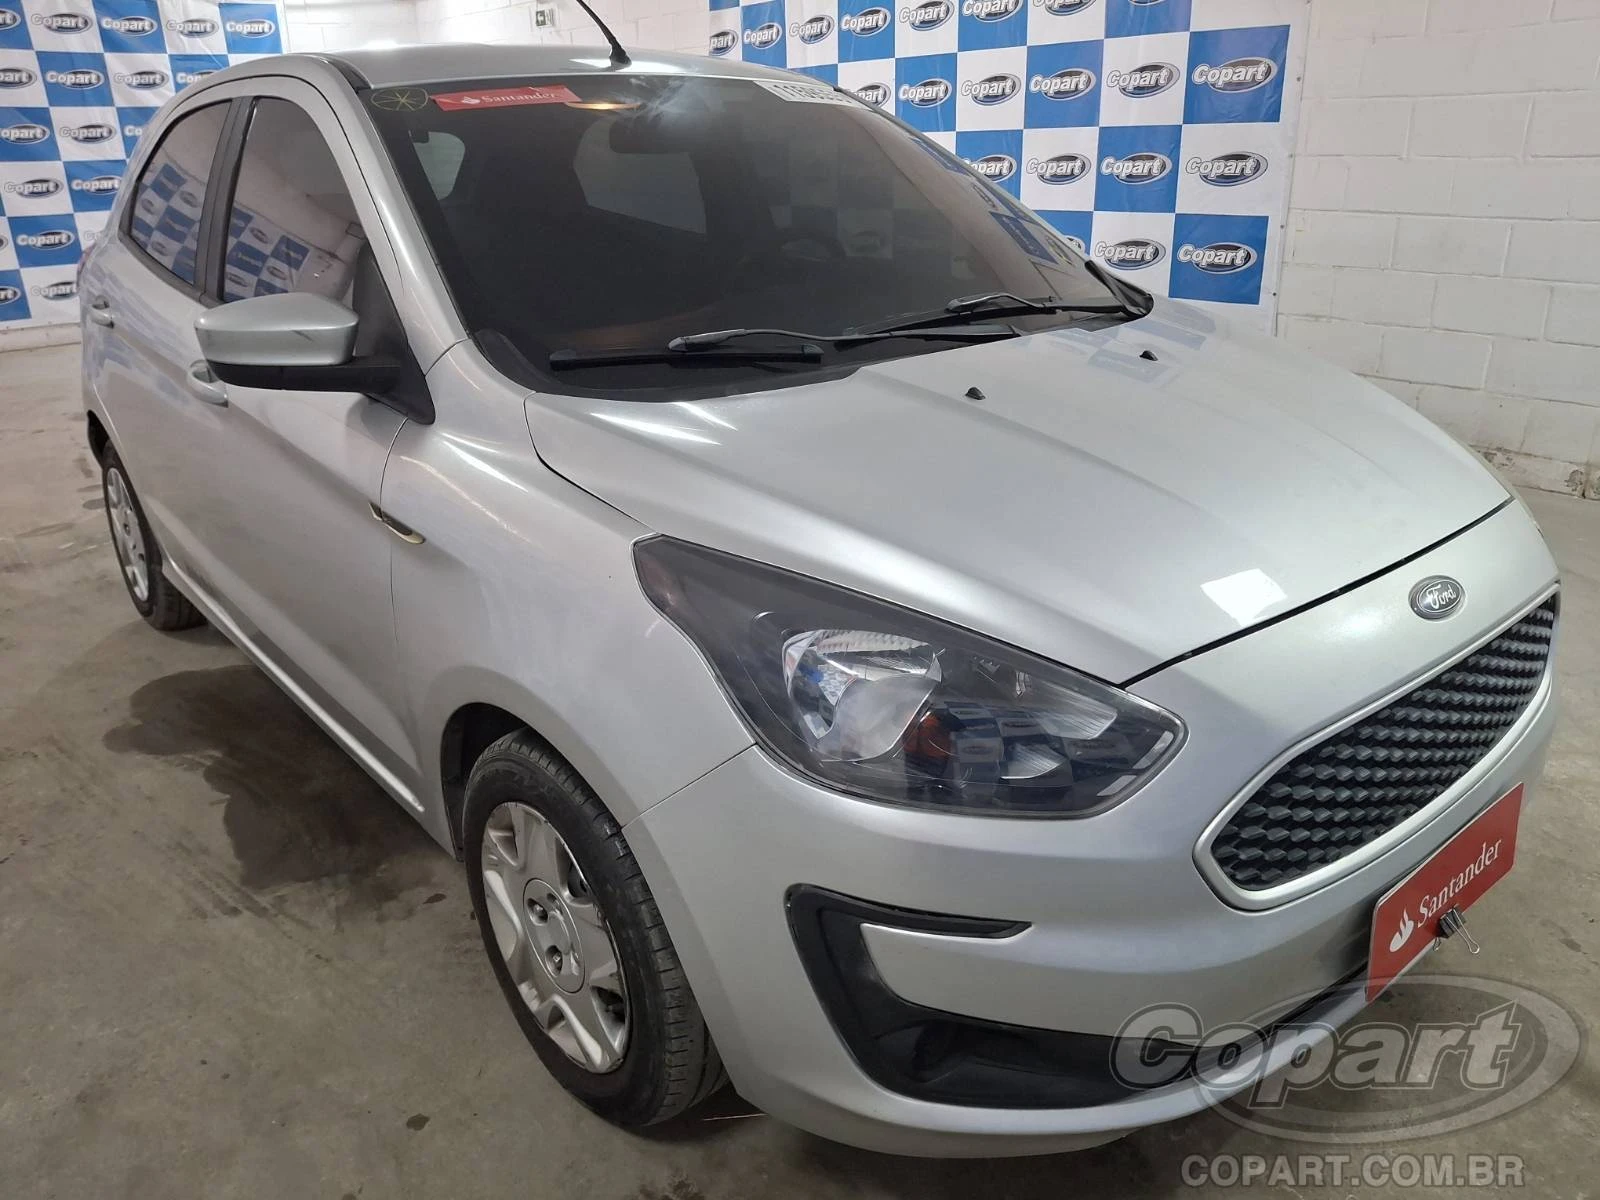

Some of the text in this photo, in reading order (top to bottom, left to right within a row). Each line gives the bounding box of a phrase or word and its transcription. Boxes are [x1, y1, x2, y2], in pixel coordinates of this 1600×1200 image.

[31, 13, 83, 29] Copart
[101, 17, 150, 32] Copart
[841, 11, 885, 33] Copart
[899, 2, 948, 27] Copart
[166, 20, 213, 35] Copart
[226, 21, 270, 35] Copart
[743, 25, 777, 46] Copart
[789, 18, 829, 40] Copart
[709, 33, 733, 50] part
[46, 70, 98, 86] Copart
[114, 72, 161, 87] Copart
[1029, 71, 1089, 96] Copart
[1106, 65, 1173, 92] Copart
[1191, 60, 1271, 85] Copart
[481, 92, 555, 102] Santander
[898, 81, 946, 103] Copart
[961, 76, 1016, 101] Copart
[0, 127, 43, 141] opart
[60, 126, 109, 141] Copart
[1026, 158, 1086, 180] Copart
[1101, 157, 1166, 181] Copart
[1185, 156, 1258, 180] Copart
[4, 181, 57, 196] Copart
[71, 179, 119, 192] Copart
[17, 233, 69, 248] Copart
[1094, 240, 1160, 266] Copart
[1178, 243, 1250, 269] Copart
[1424, 584, 1457, 609] Ford
[1417, 839, 1502, 929] Santander
